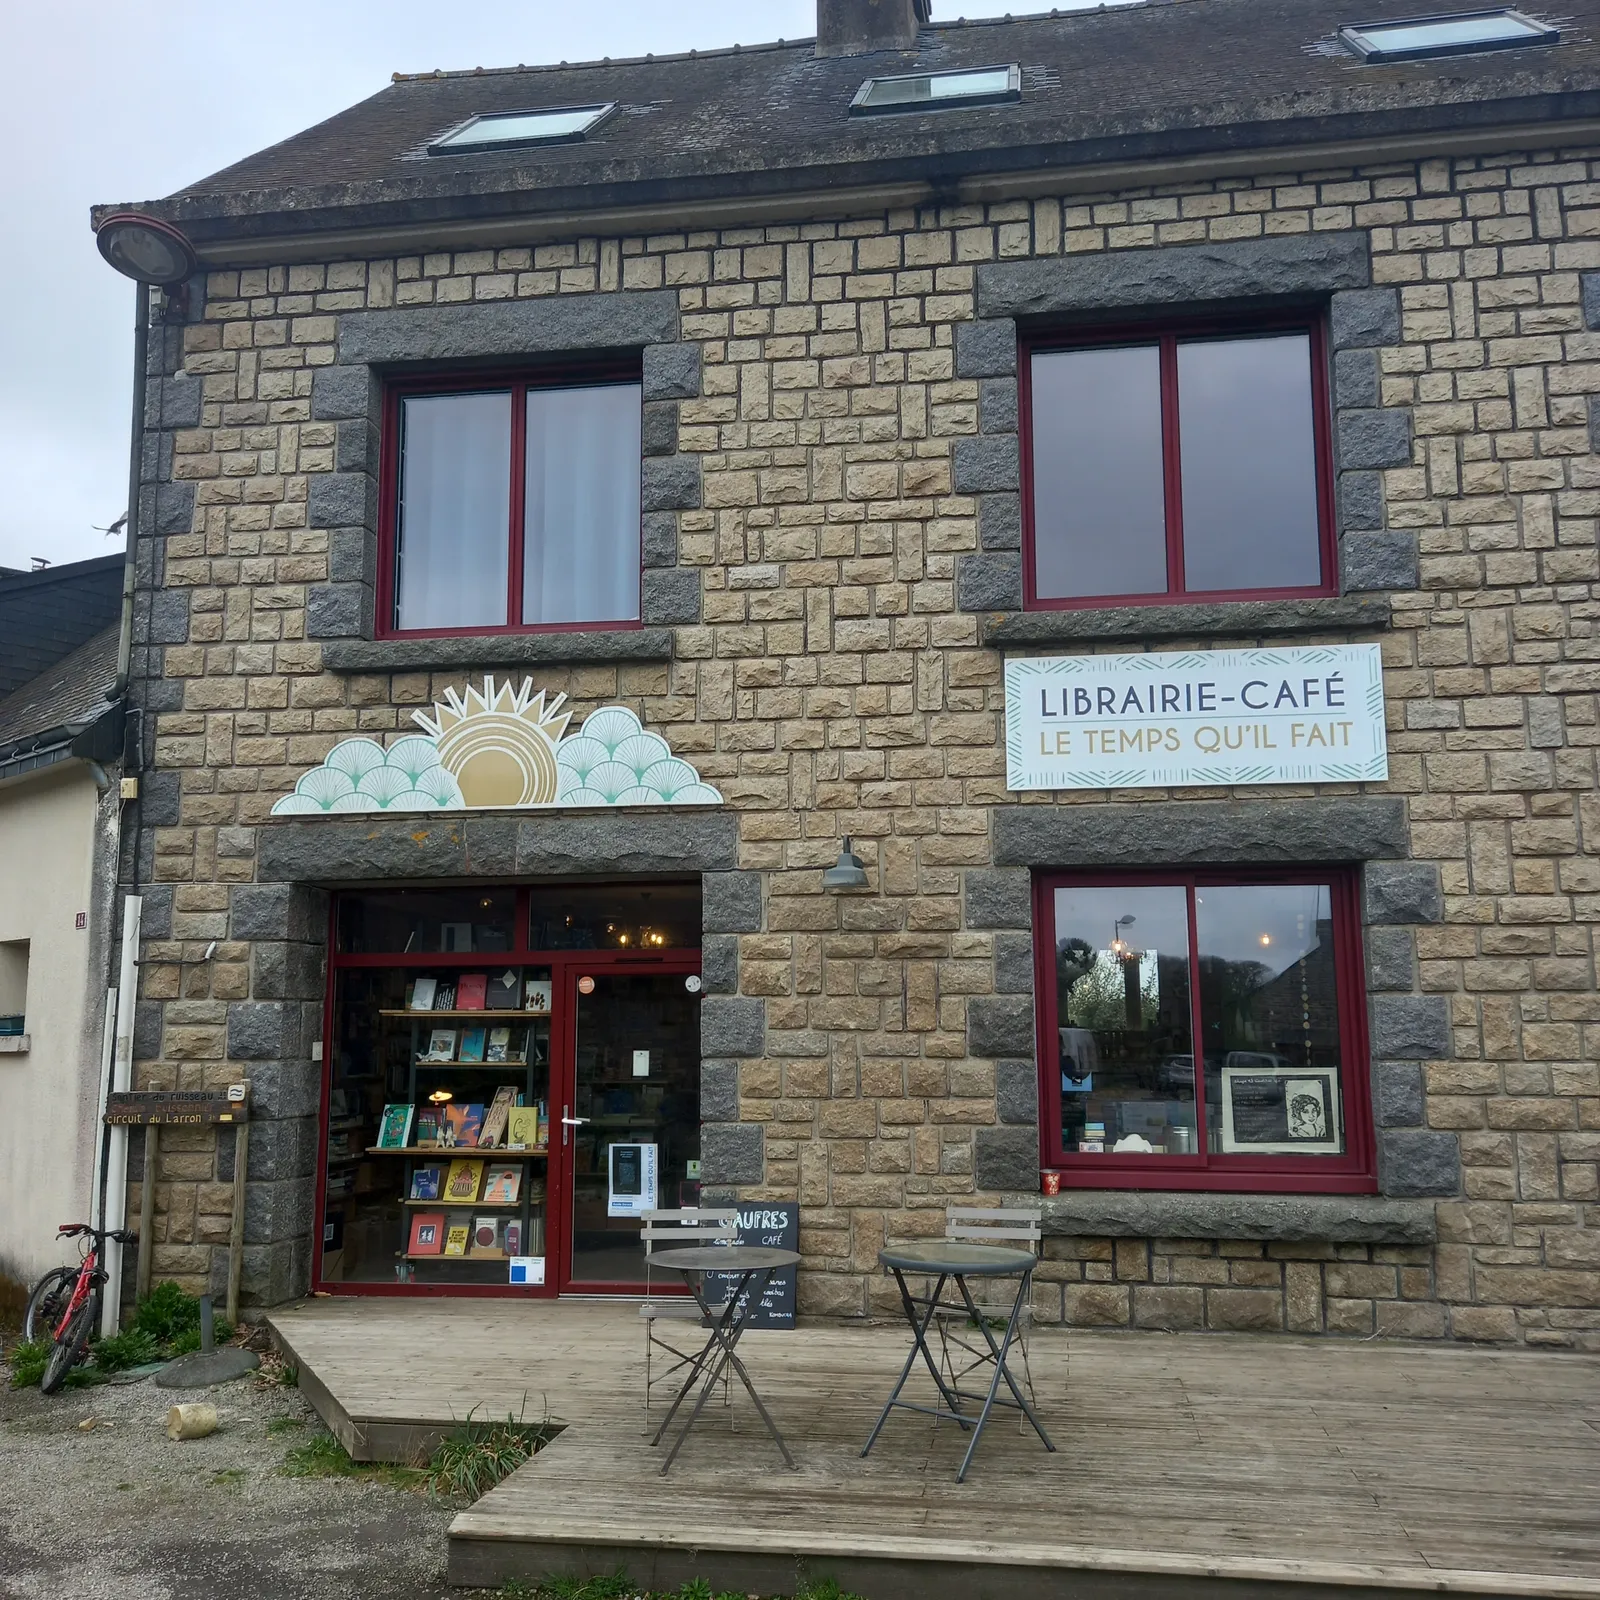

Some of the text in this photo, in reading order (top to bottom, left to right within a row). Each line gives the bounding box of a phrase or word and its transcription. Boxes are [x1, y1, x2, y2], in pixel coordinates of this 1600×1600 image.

[1041, 671, 1345, 717] LIBRAIRIE-CAFÉ
[1040, 721, 1354, 755] LE TEMPS QU'IL FAIT
[171, 1091, 214, 1101] ruisseau
[107, 1114, 142, 1123] circuit
[149, 1114, 161, 1123] du
[166, 1113, 201, 1123] Larron
[762, 1232, 783, 1245] CAFÉ
